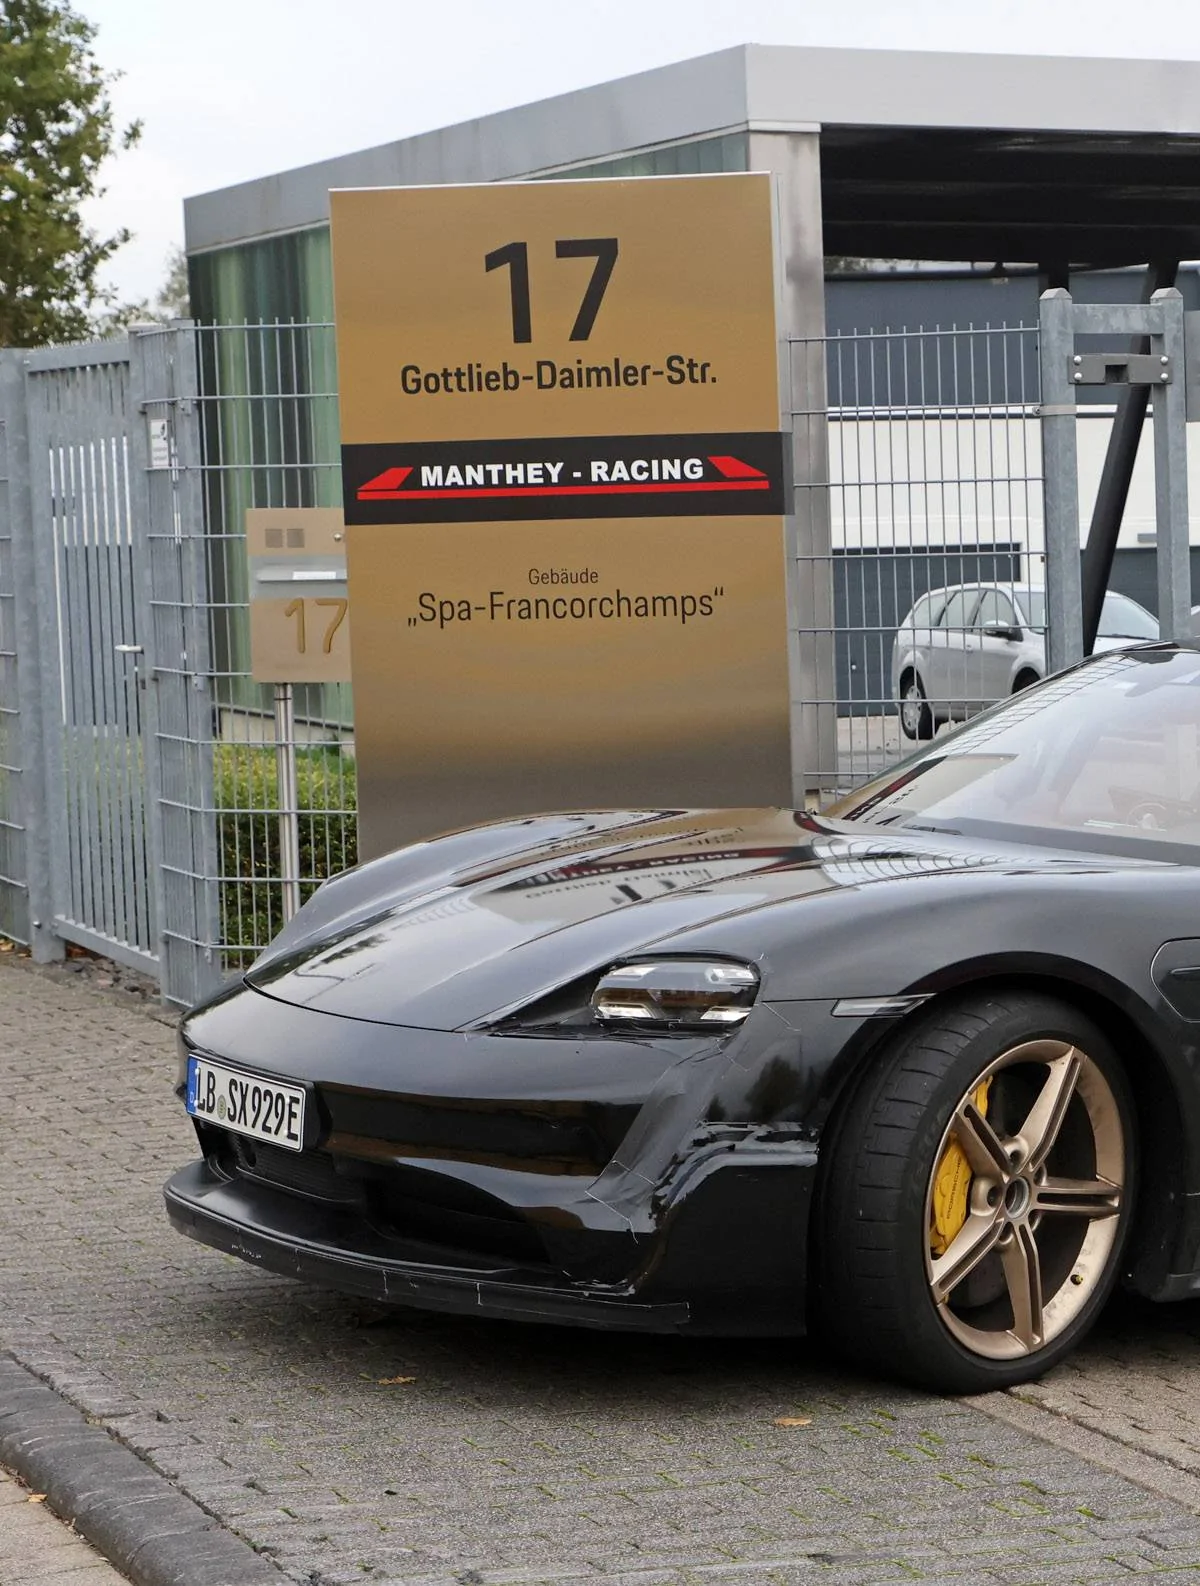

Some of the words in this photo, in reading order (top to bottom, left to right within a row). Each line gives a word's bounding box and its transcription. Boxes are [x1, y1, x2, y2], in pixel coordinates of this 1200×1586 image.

[484, 238, 619, 344] 17
[400, 354, 718, 395] Gottlieb-Daimler-Str.
[420, 461, 564, 488] MANTHEY
[590, 457, 704, 483] RACING
[528, 566, 600, 585] Gebäude
[284, 597, 348, 654] 17
